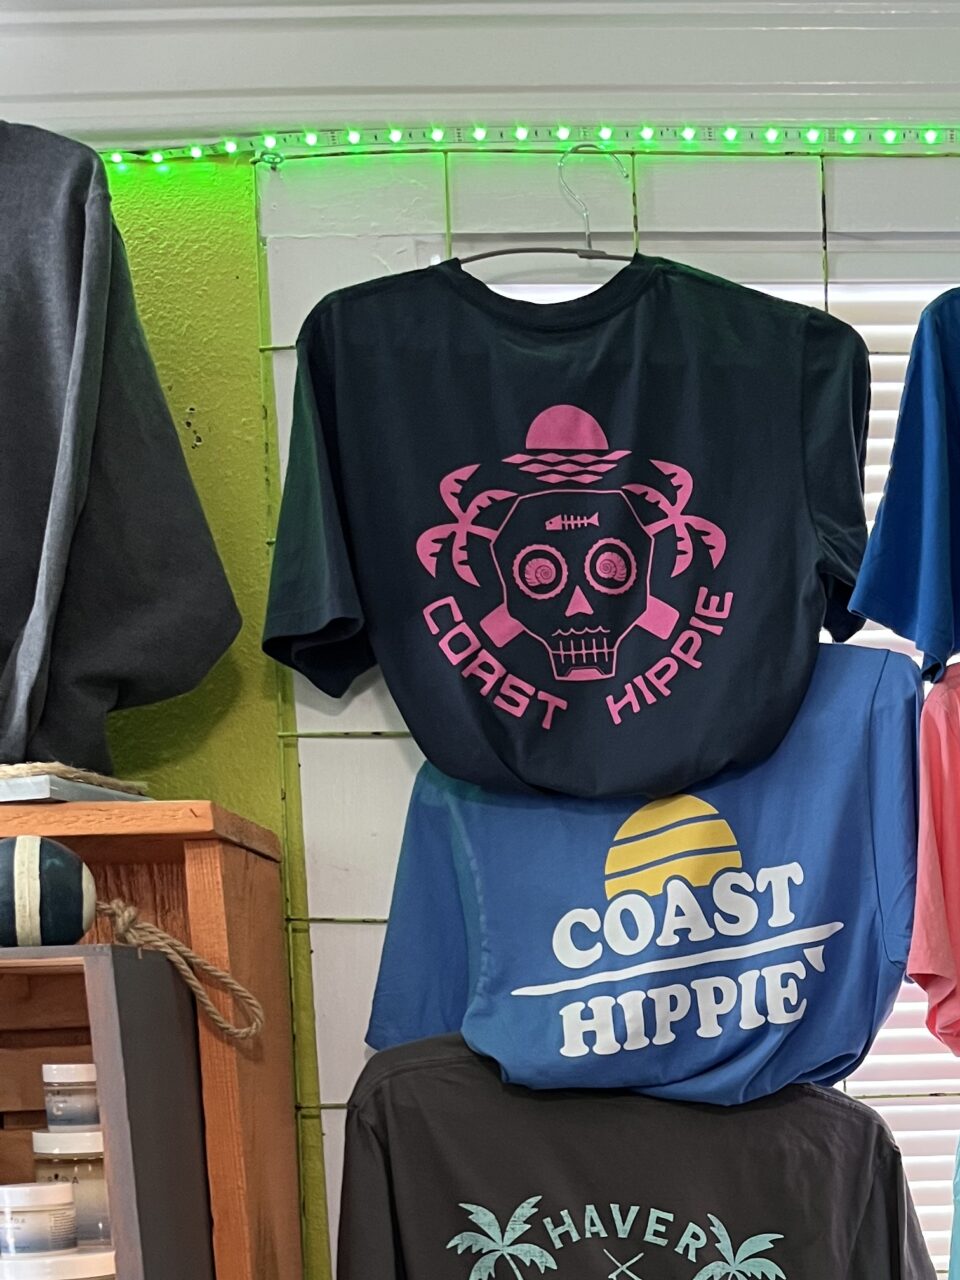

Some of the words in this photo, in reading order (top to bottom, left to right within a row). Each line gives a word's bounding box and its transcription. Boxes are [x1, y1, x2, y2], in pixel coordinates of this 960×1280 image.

[422, 596, 568, 730] COAST
[605, 586, 735, 726] HIPPIE
[552, 862, 805, 969] COAST
[559, 960, 808, 1058] HIPPIE
[542, 1203, 708, 1263] HAVER
